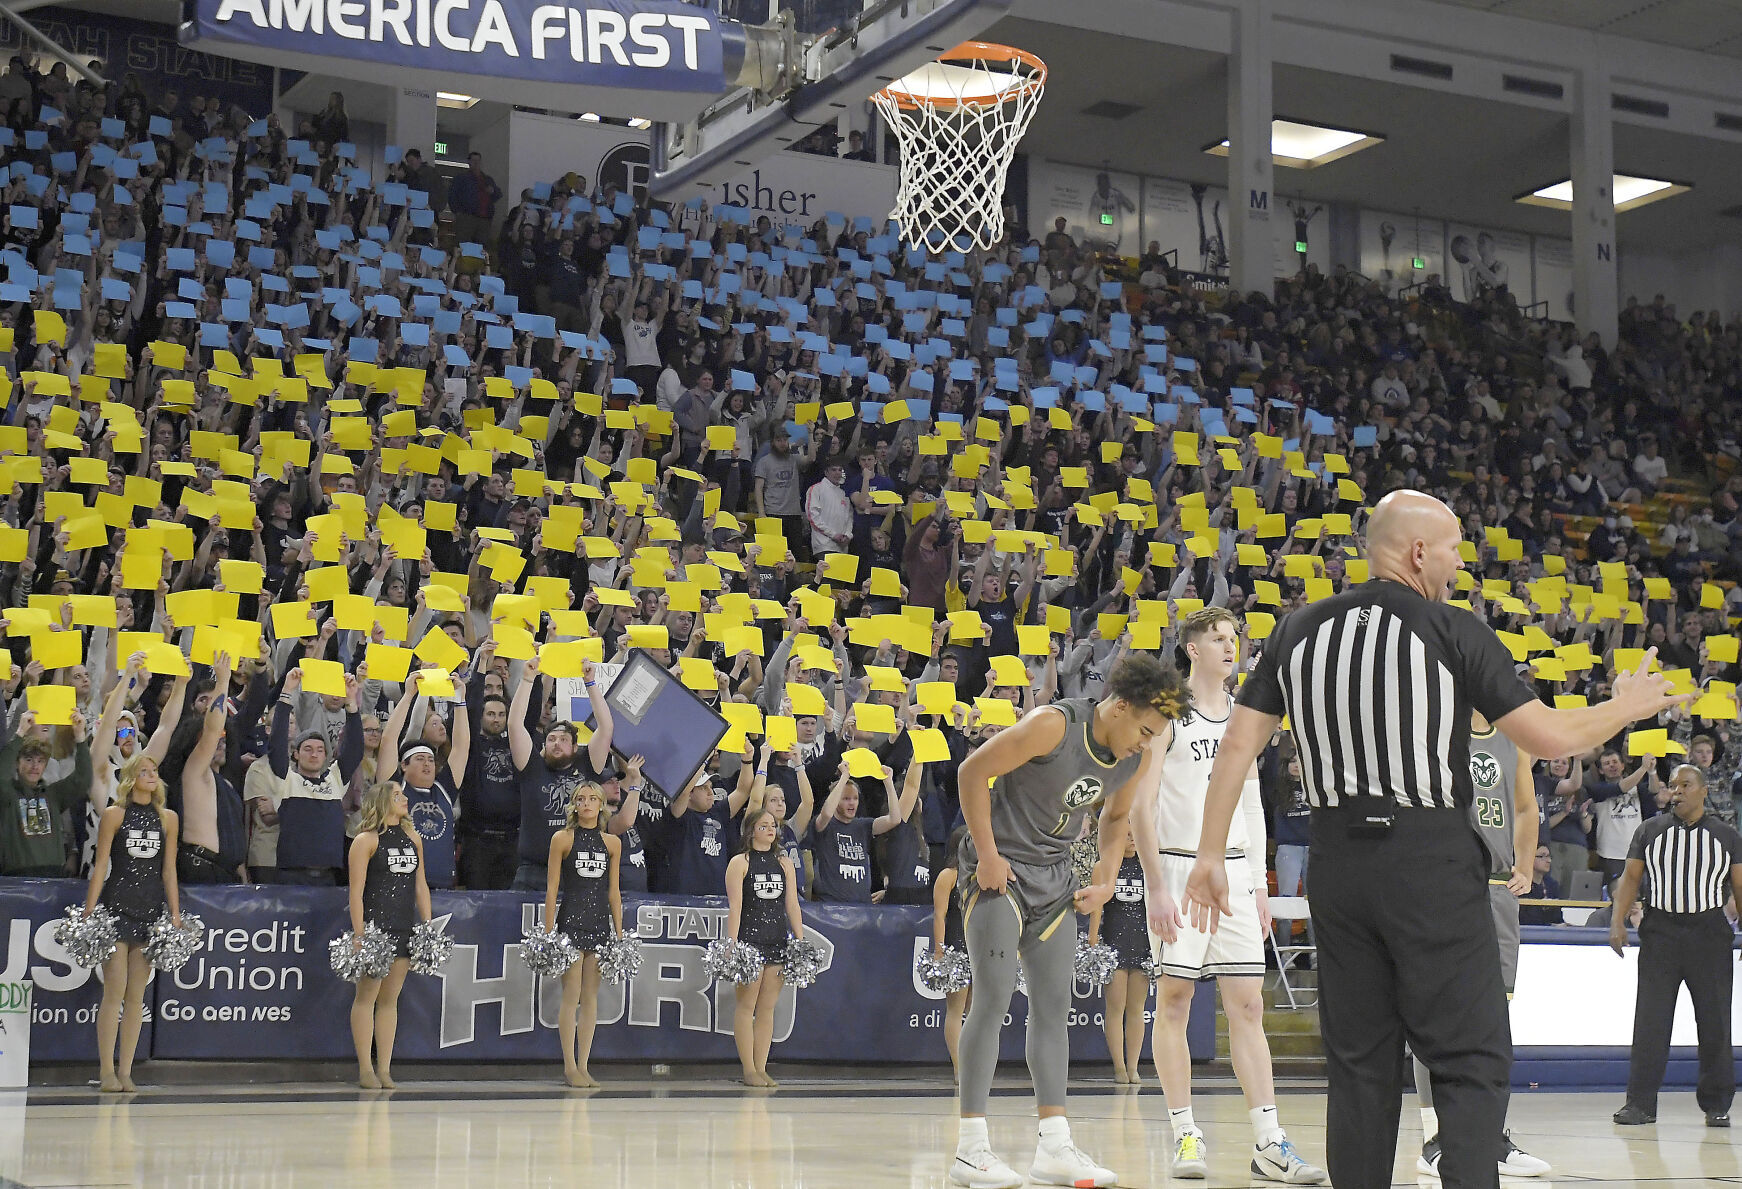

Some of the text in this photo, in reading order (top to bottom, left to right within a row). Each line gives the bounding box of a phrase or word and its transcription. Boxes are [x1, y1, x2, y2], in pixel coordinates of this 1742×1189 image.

[215, 0, 712, 71] AMERICA FIRST
[434, 142, 448, 155] EXIT
[721, 169, 817, 216] isher
[1251, 190, 1268, 209] M
[1597, 244, 1610, 262] N
[1190, 738, 1220, 762] STA
[1475, 796, 1505, 828] 23
[125, 838, 161, 850] STATE
[387, 855, 418, 866] STATE
[838, 850, 866, 861] BLUE
[574, 859, 607, 871] STATE
[753, 882, 784, 891] STATE
[1114, 885, 1143, 895] STATE
[173, 957, 304, 991] Union
[75, 1003, 98, 1024] of
[160, 999, 196, 1022] Go
